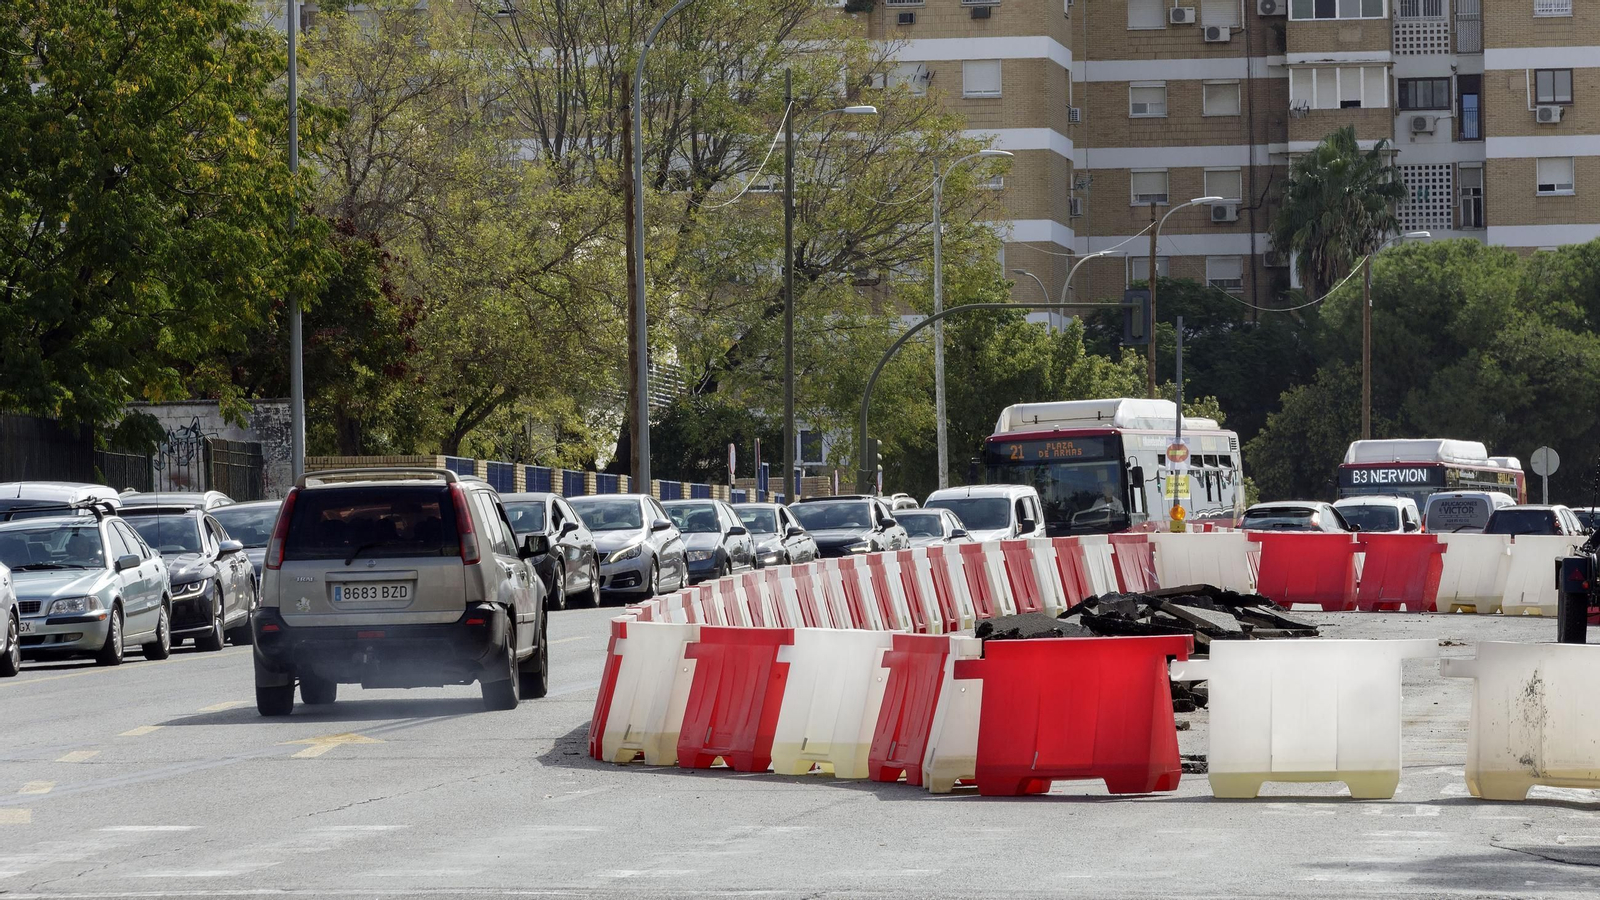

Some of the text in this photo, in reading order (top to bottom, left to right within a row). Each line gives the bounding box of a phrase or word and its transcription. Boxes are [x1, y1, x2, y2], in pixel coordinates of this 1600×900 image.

[1046, 441, 1074, 451] PLAZA
[1010, 444, 1025, 460] 21
[1038, 448, 1083, 458] DE ARMAS
[1353, 468, 1427, 484] B3 NERVION
[1443, 506, 1474, 514] VICTOR
[343, 585, 408, 600] 8683 BZD
[20, 622, 31, 632] GX
